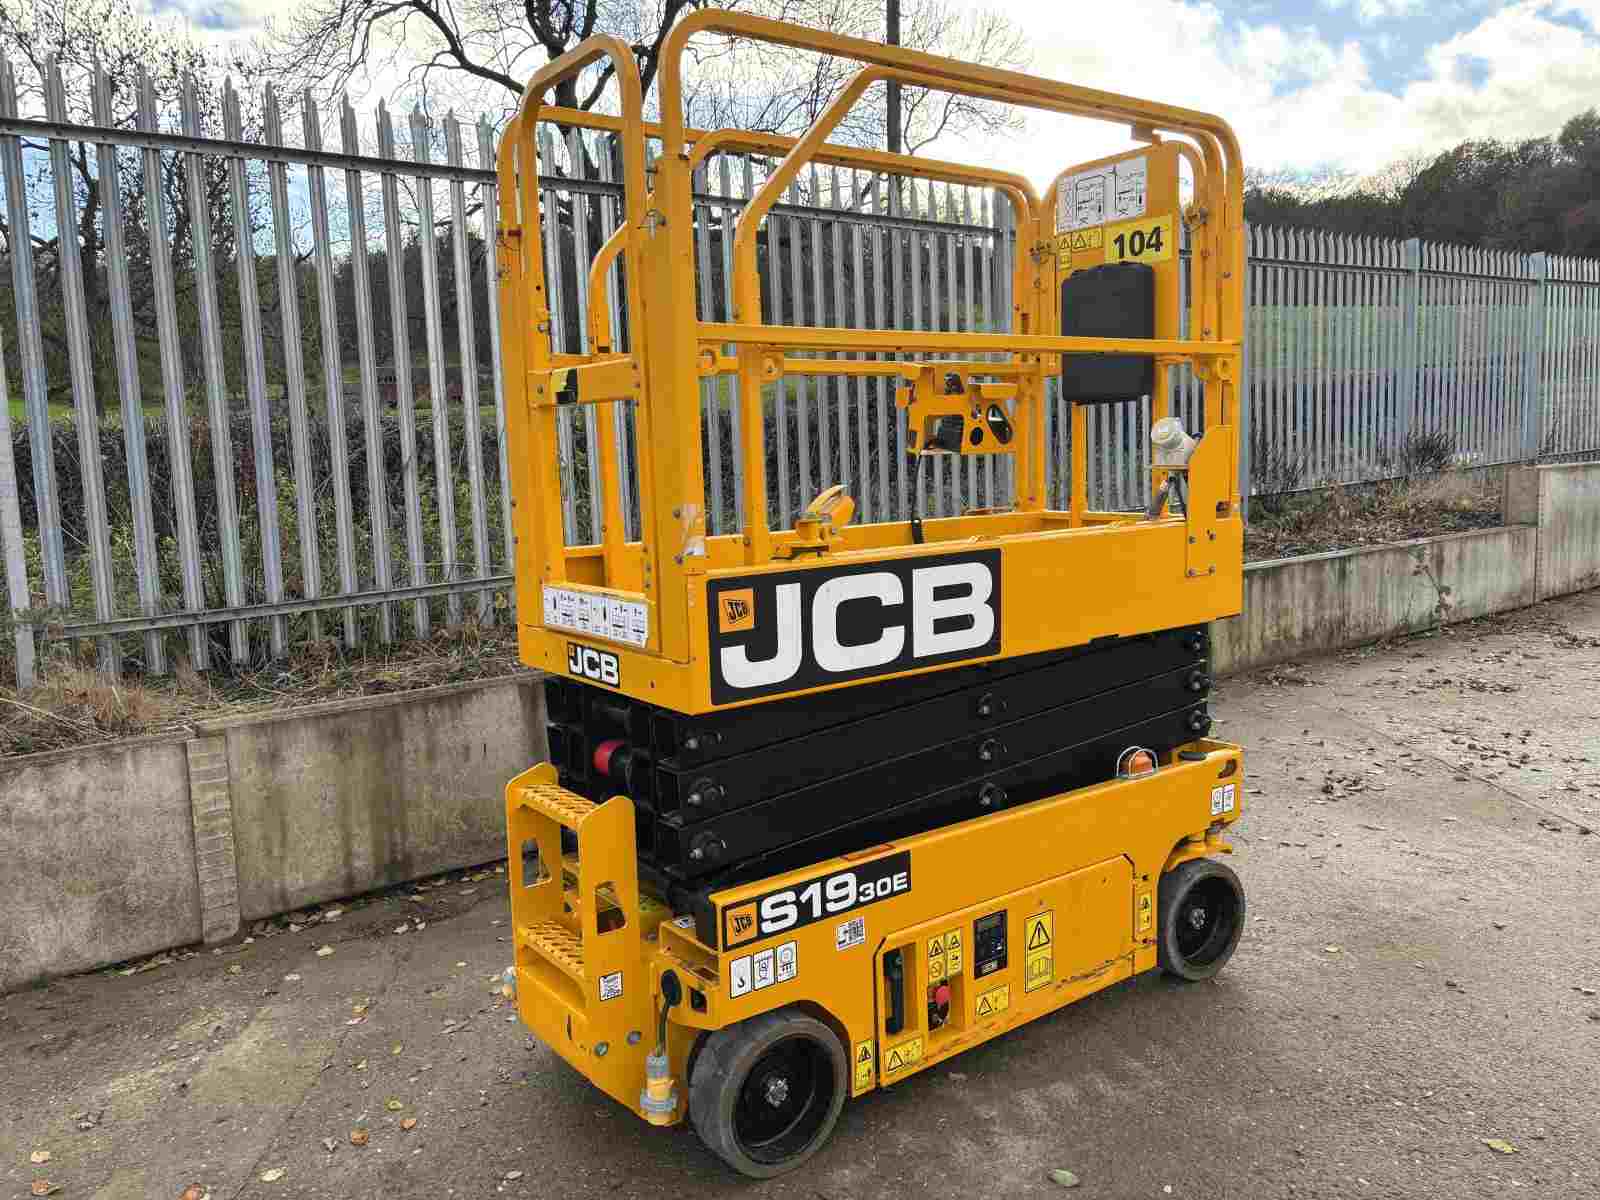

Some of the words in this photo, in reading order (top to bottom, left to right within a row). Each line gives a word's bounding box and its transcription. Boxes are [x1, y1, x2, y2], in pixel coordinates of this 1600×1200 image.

[1113, 226, 1163, 259] 104
[720, 562, 995, 689] JCB
[569, 645, 619, 685] JCB
